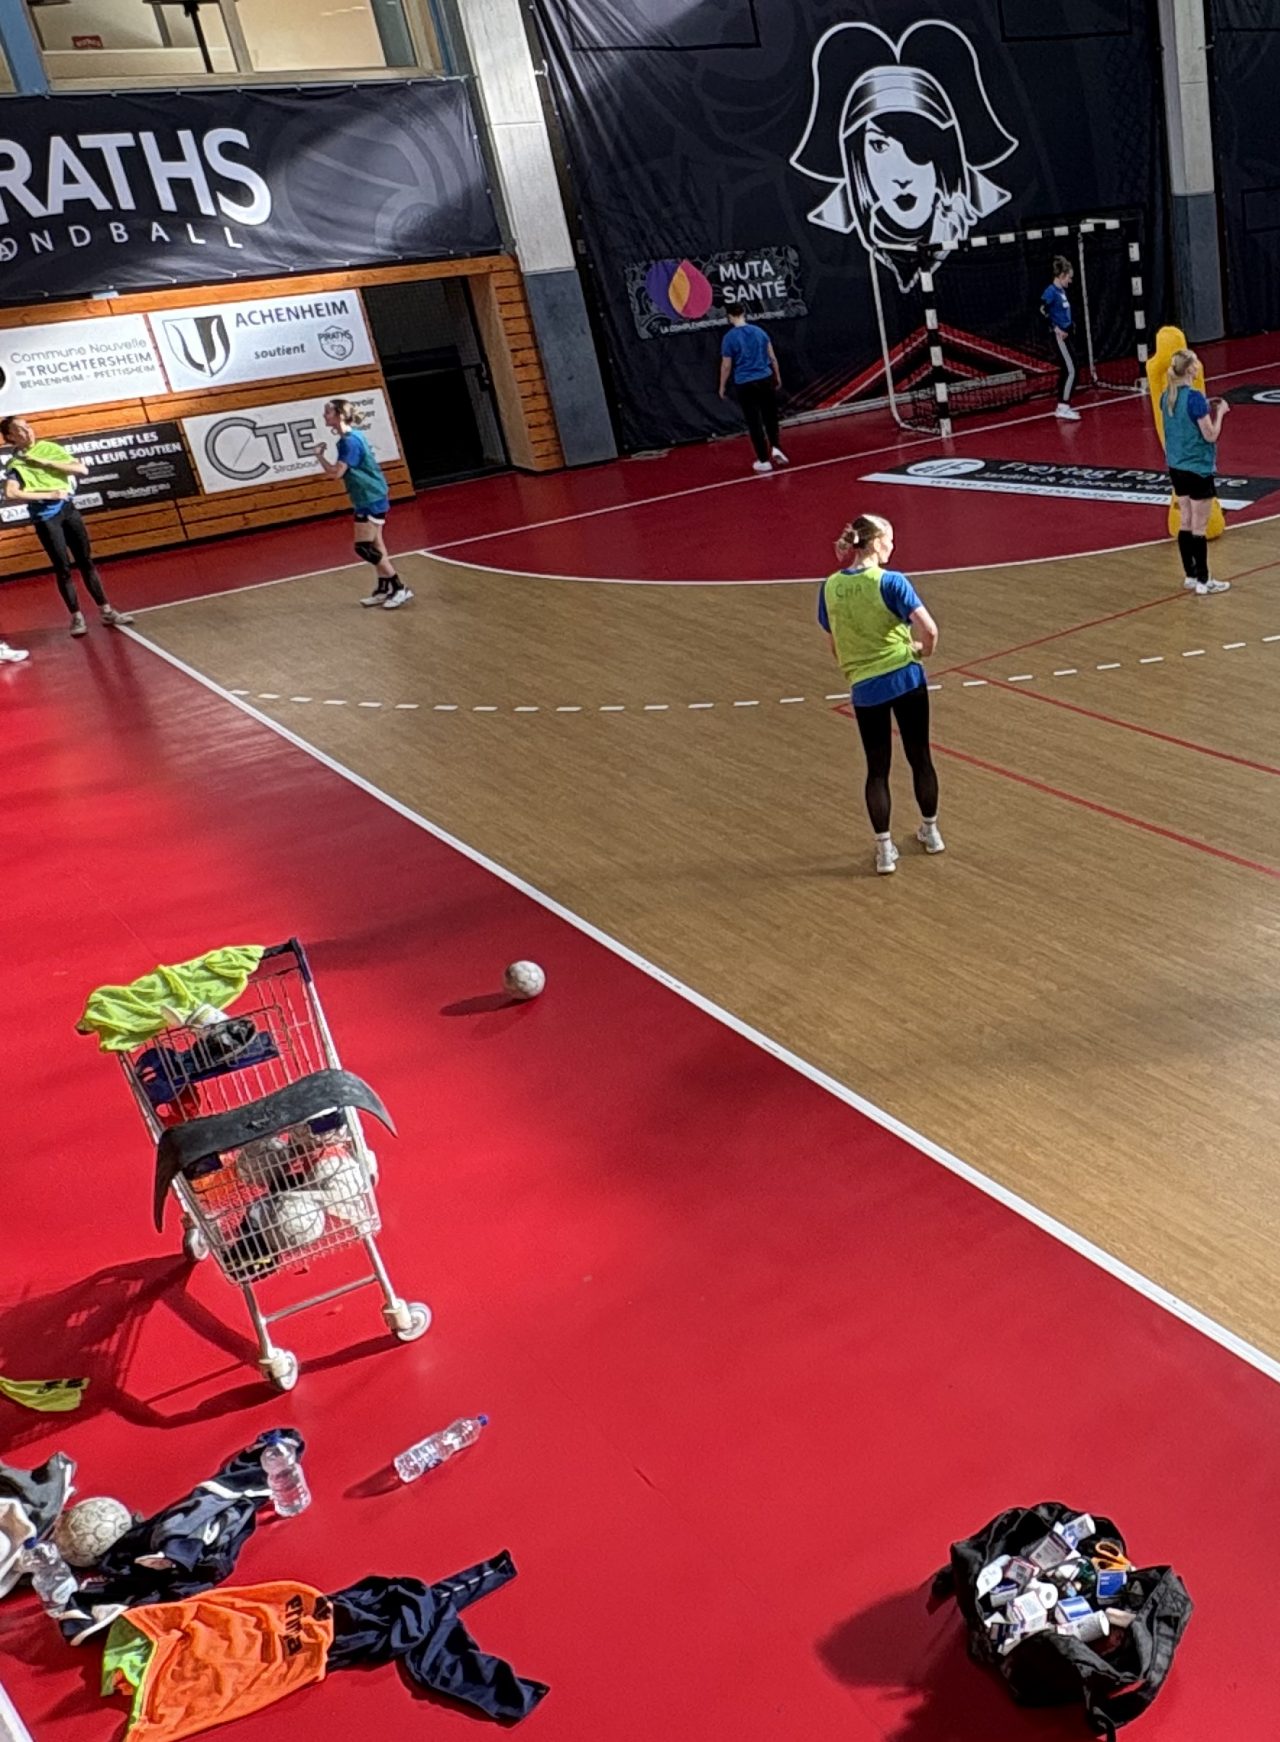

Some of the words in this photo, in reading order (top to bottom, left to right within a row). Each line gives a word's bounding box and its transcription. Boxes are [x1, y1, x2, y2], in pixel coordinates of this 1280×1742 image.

[719, 259, 776, 282] MUTA
[722, 275, 788, 304] SANTÉ
[235, 299, 349, 327] ACHENHEIM
[10, 345, 87, 364] Commune
[89, 337, 147, 354] Nouvelle
[254, 342, 306, 359] soutient
[27, 351, 153, 377] TRUCHTERSHEIM
[64, 434, 135, 454] EMERCIENT
[136, 431, 159, 443] LES
[94, 449, 129, 466] LEUR
[129, 442, 182, 460] SOUTIEN
[205, 416, 317, 480] CTE
